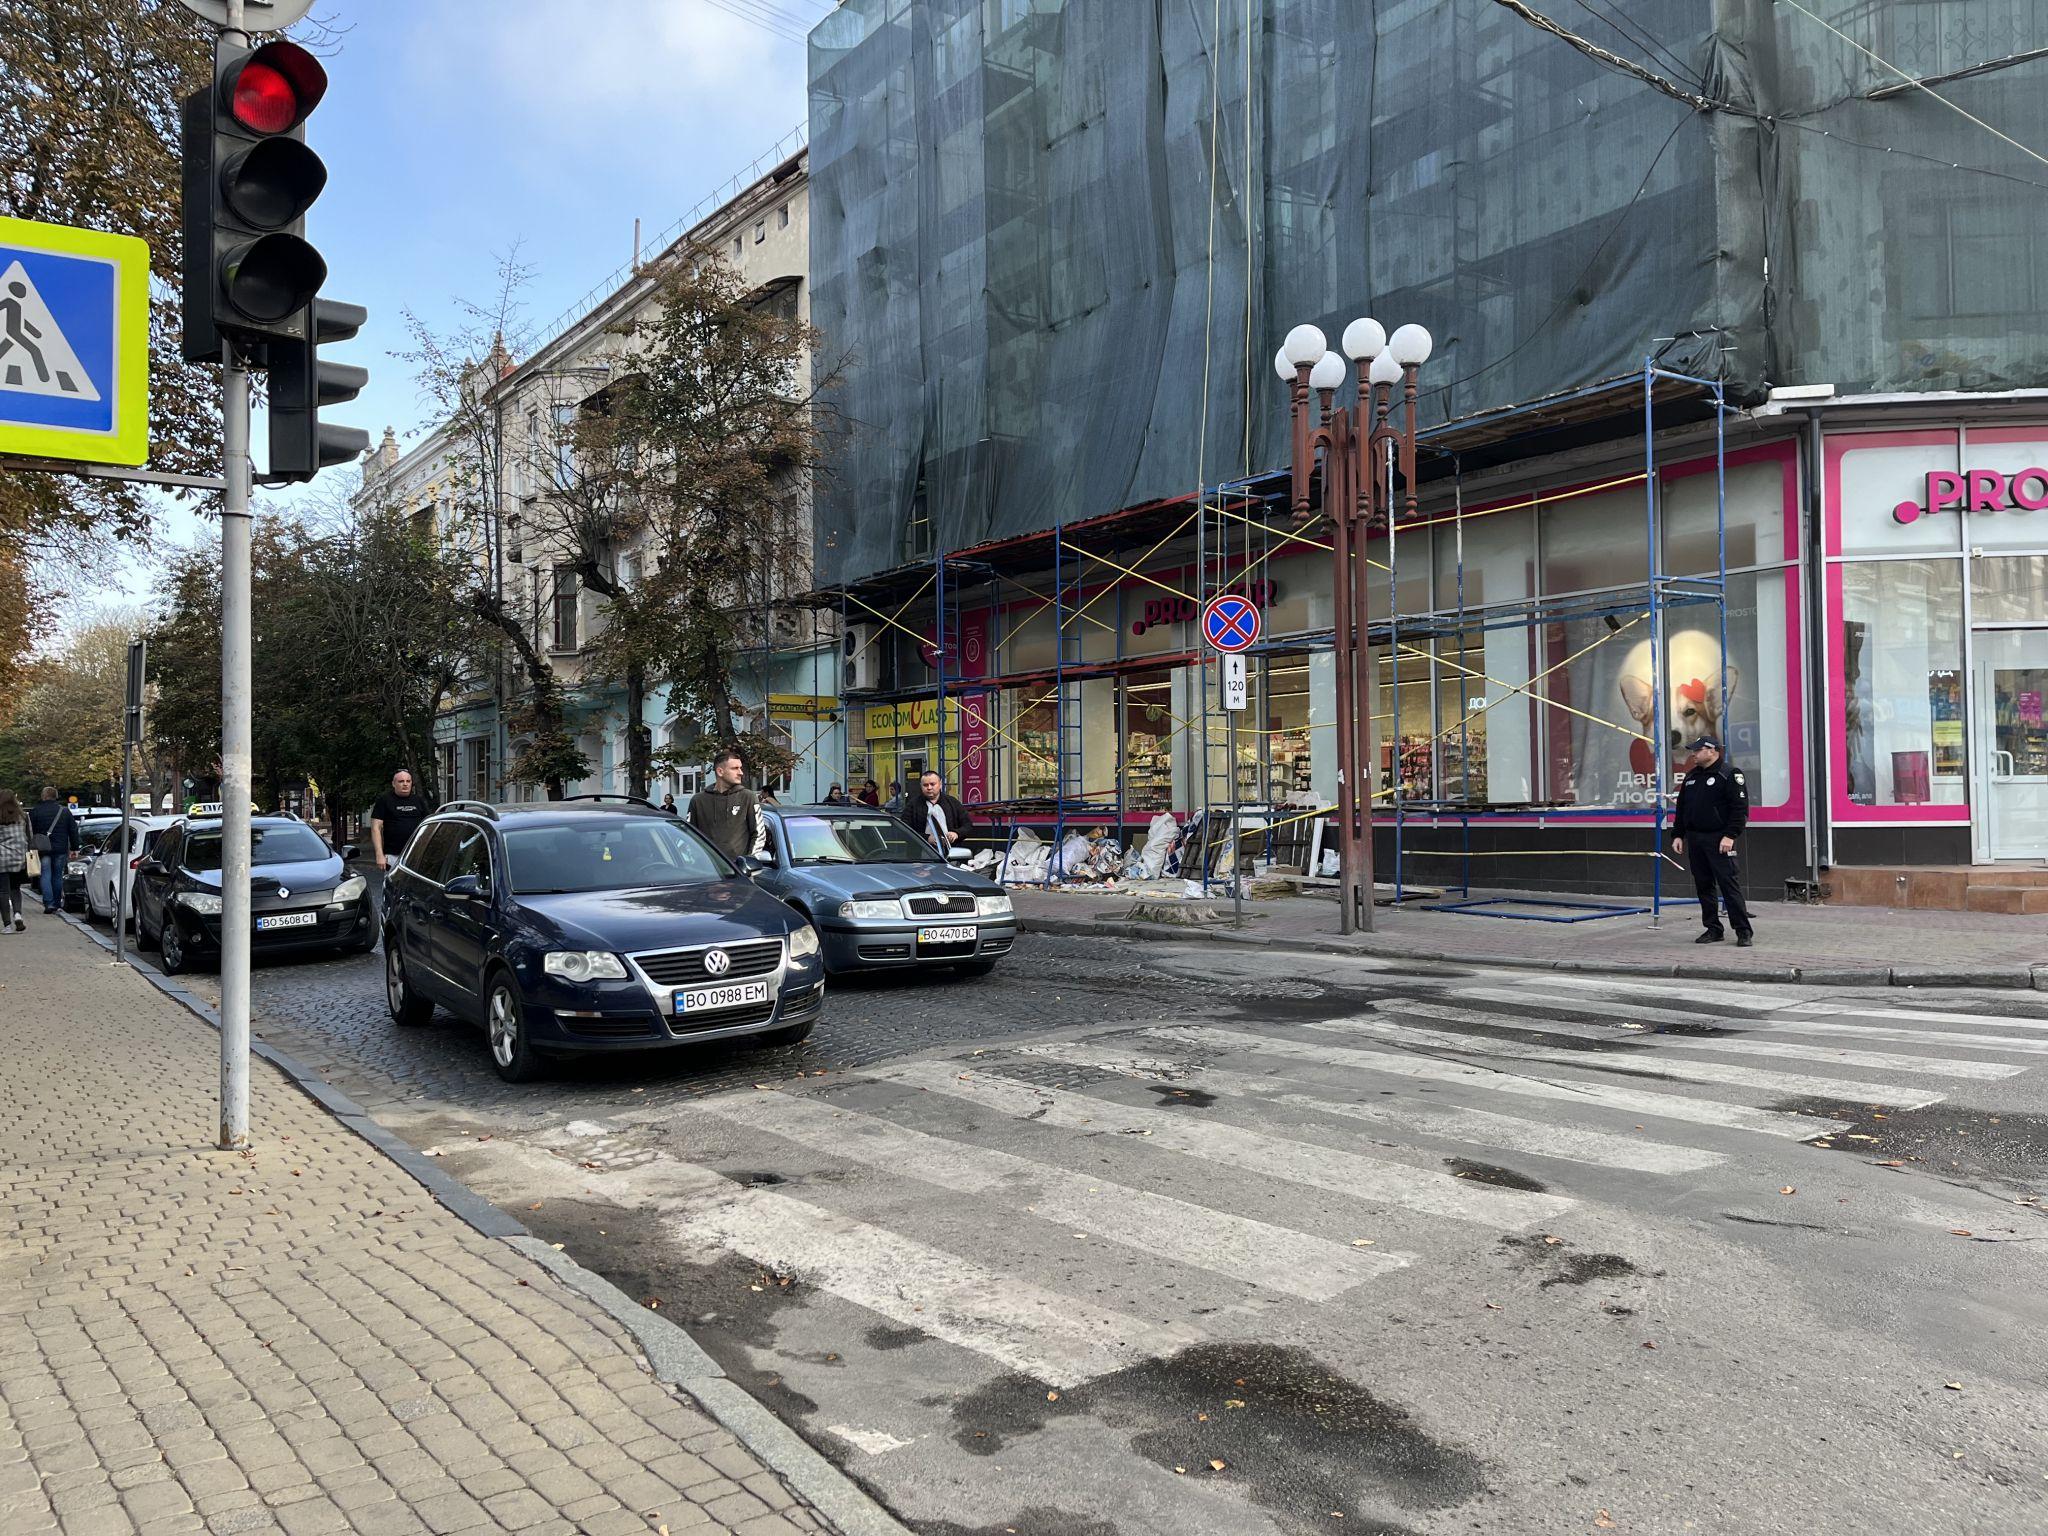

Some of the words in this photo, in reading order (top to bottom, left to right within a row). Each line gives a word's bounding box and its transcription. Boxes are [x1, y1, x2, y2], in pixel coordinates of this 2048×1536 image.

[1227, 680, 1244, 691] 120
[1617, 771, 1657, 788] Дар
[1612, 788, 1657, 804] люб
[263, 918, 277, 928] BO
[279, 915, 301, 926] 5608
[924, 929, 938, 940] BO
[939, 928, 961, 940] 4470
[962, 927, 975, 939] BC
[686, 992, 707, 1008] BO
[710, 987, 742, 1005] 0988
[745, 984, 765, 1000] EM
